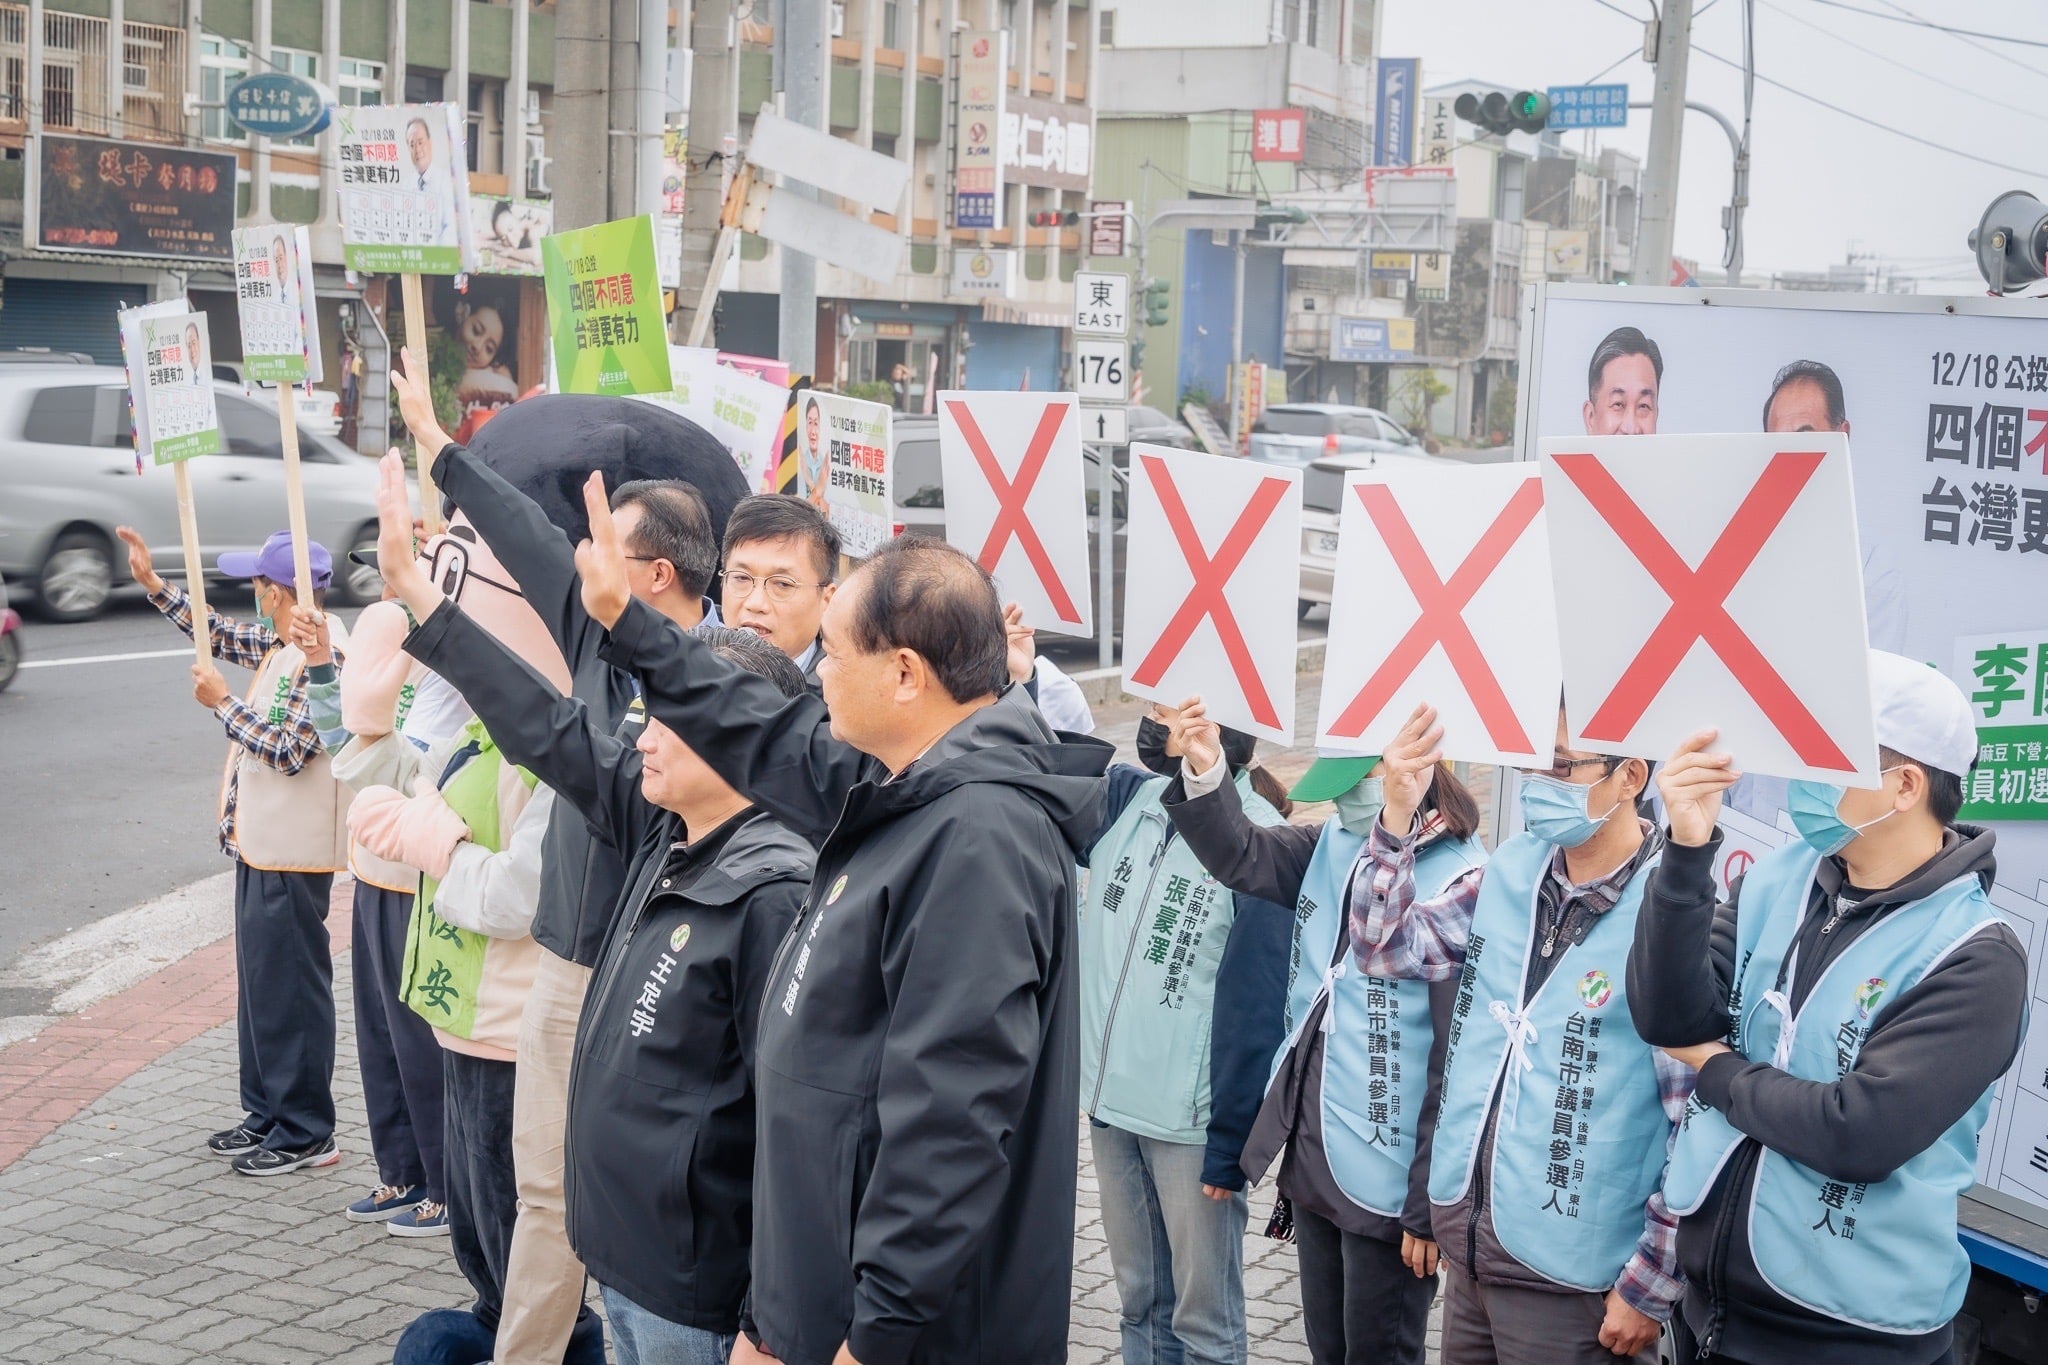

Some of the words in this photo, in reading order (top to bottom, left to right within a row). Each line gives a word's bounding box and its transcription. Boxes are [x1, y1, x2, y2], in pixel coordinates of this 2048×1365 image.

[962, 104, 995, 112] KYMCO
[340, 143, 399, 162] 四個不同意
[343, 165, 400, 184] 台灣更有力
[238, 260, 271, 279] 四個不同意
[240, 281, 272, 299] 台灣更有力
[569, 272, 636, 313] 四個不同意
[1090, 280, 1114, 307] 東
[574, 311, 640, 350] 台灣更有力
[1078, 312, 1123, 327] EAST
[147, 346, 183, 367] 四個不同意
[1080, 354, 1122, 385] 176
[150, 367, 184, 387] 台灣更有力
[1932, 351, 1999, 389] 12/18
[2004, 354, 2048, 393] 公投
[830, 439, 886, 474] 四個不同意
[831, 468, 886, 498] 台灣不會亂下去
[1971, 643, 2048, 718] 李
[1979, 742, 2009, 764] 麻豆
[2012, 741, 2042, 762] 下營
[1103, 856, 1135, 914] 秘書
[1143, 874, 1191, 966] 張豪澤
[1159, 885, 1207, 1009] 台南市議員參選人
[630, 952, 678, 1038] 王定宇
[1541, 1010, 1587, 1217] 台南市議員參選人
